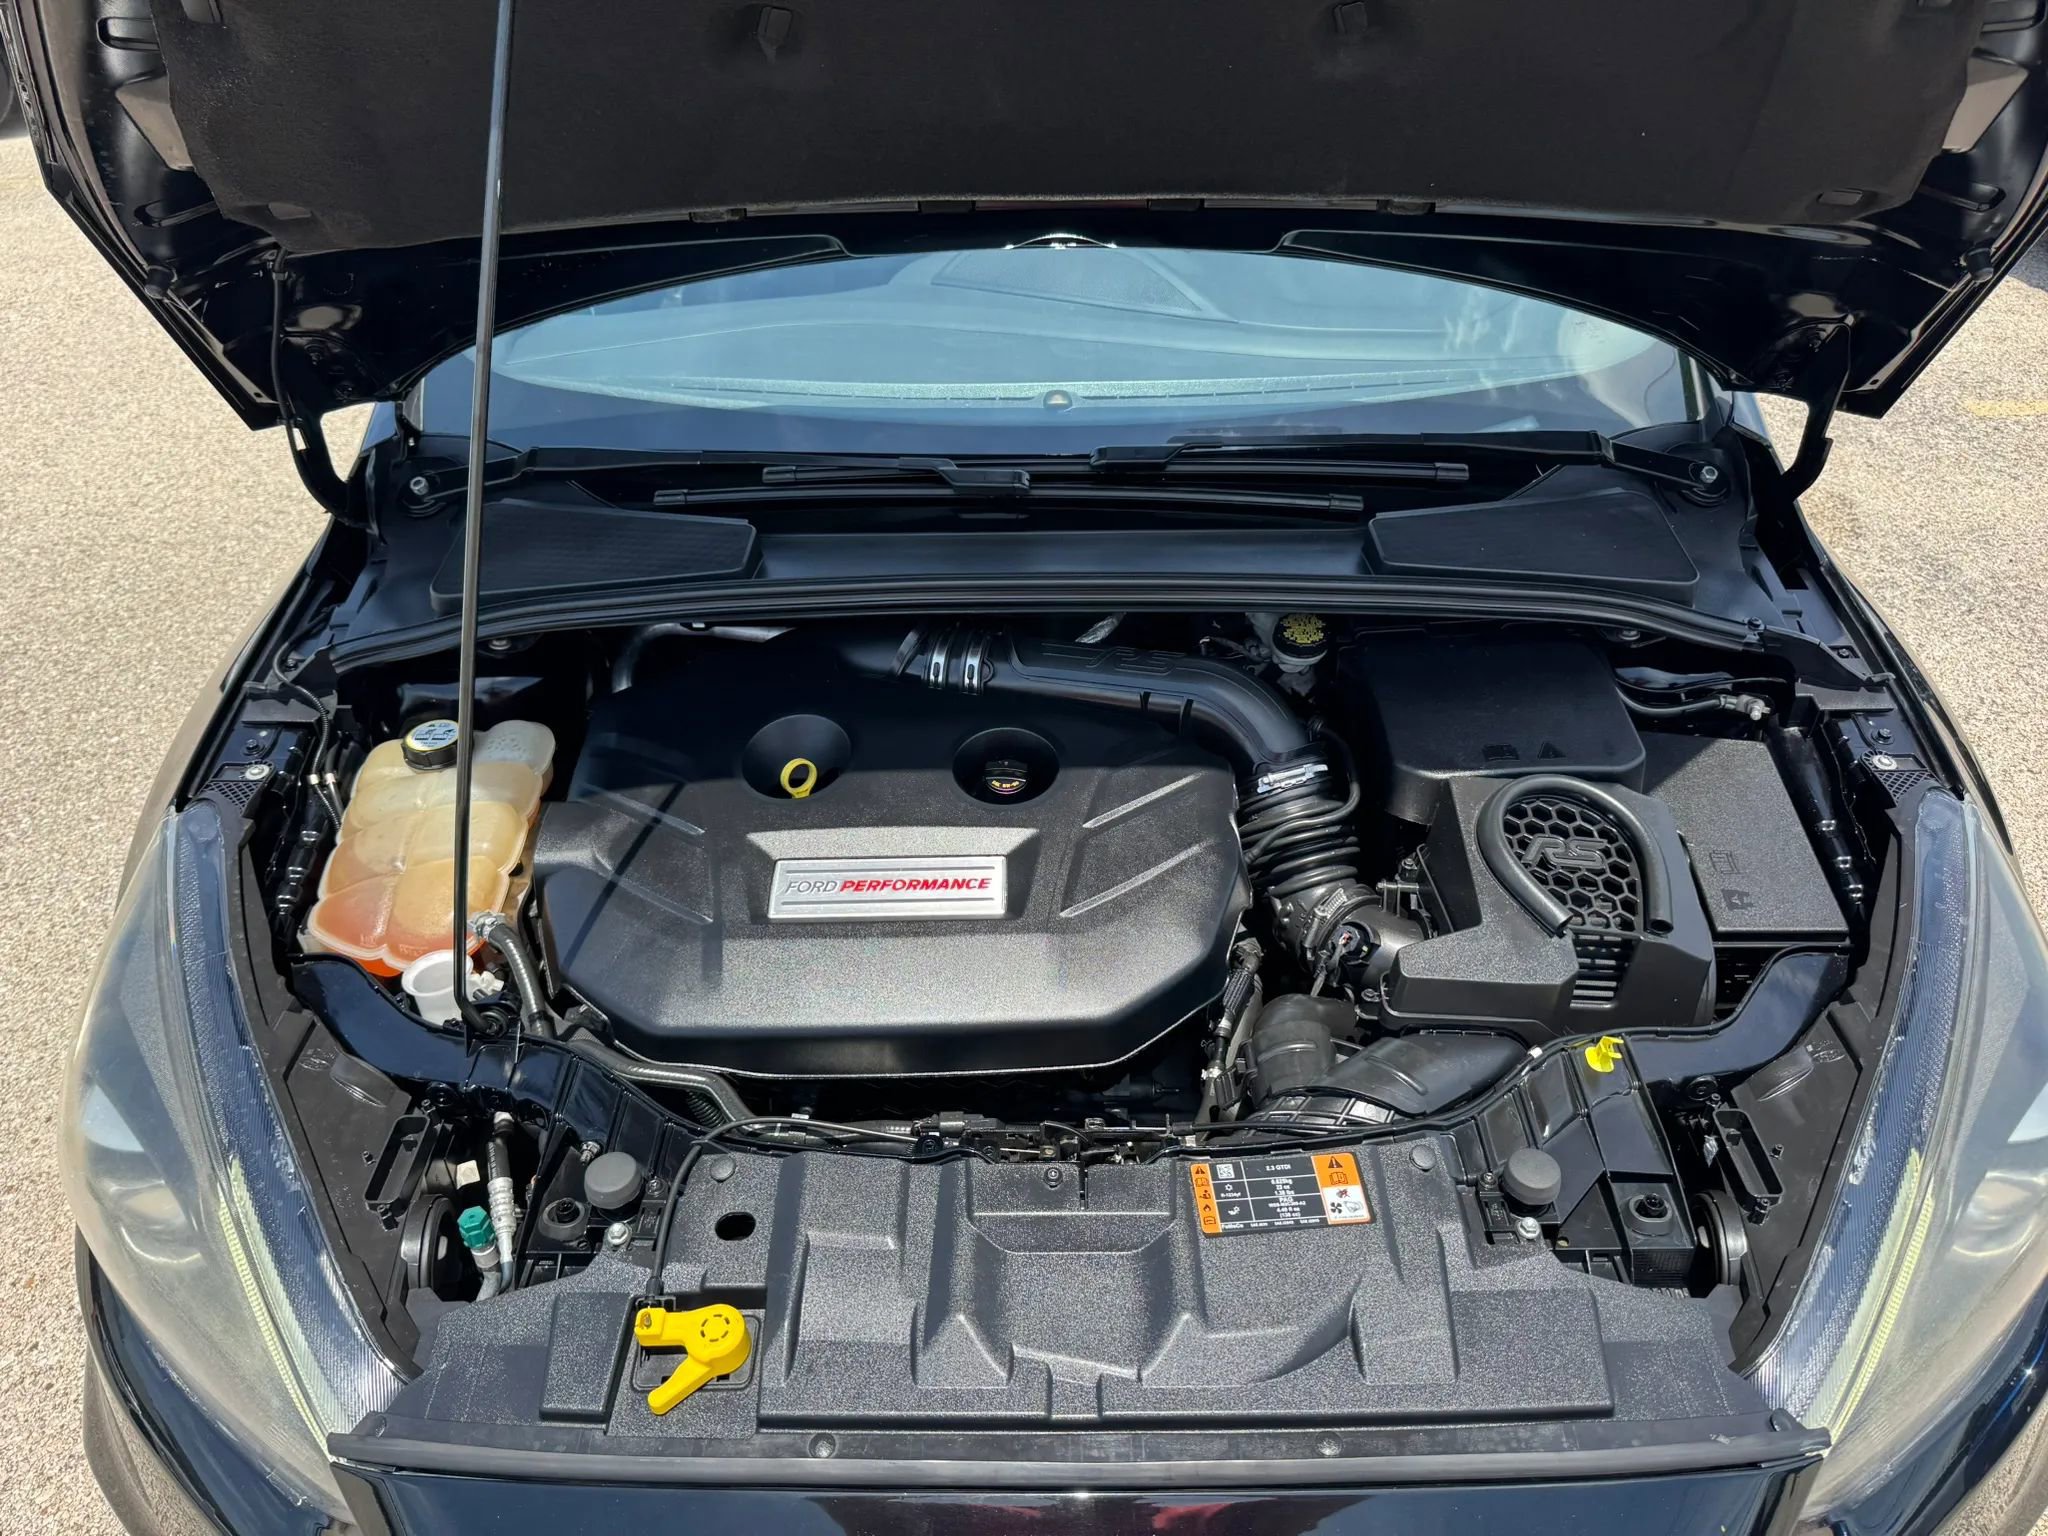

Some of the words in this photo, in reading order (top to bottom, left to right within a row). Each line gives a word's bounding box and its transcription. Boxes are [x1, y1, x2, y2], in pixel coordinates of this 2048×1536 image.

[1522, 833, 1608, 869] RS
[784, 880, 838, 895] FORD
[839, 877, 993, 893] PERFORMANCE
